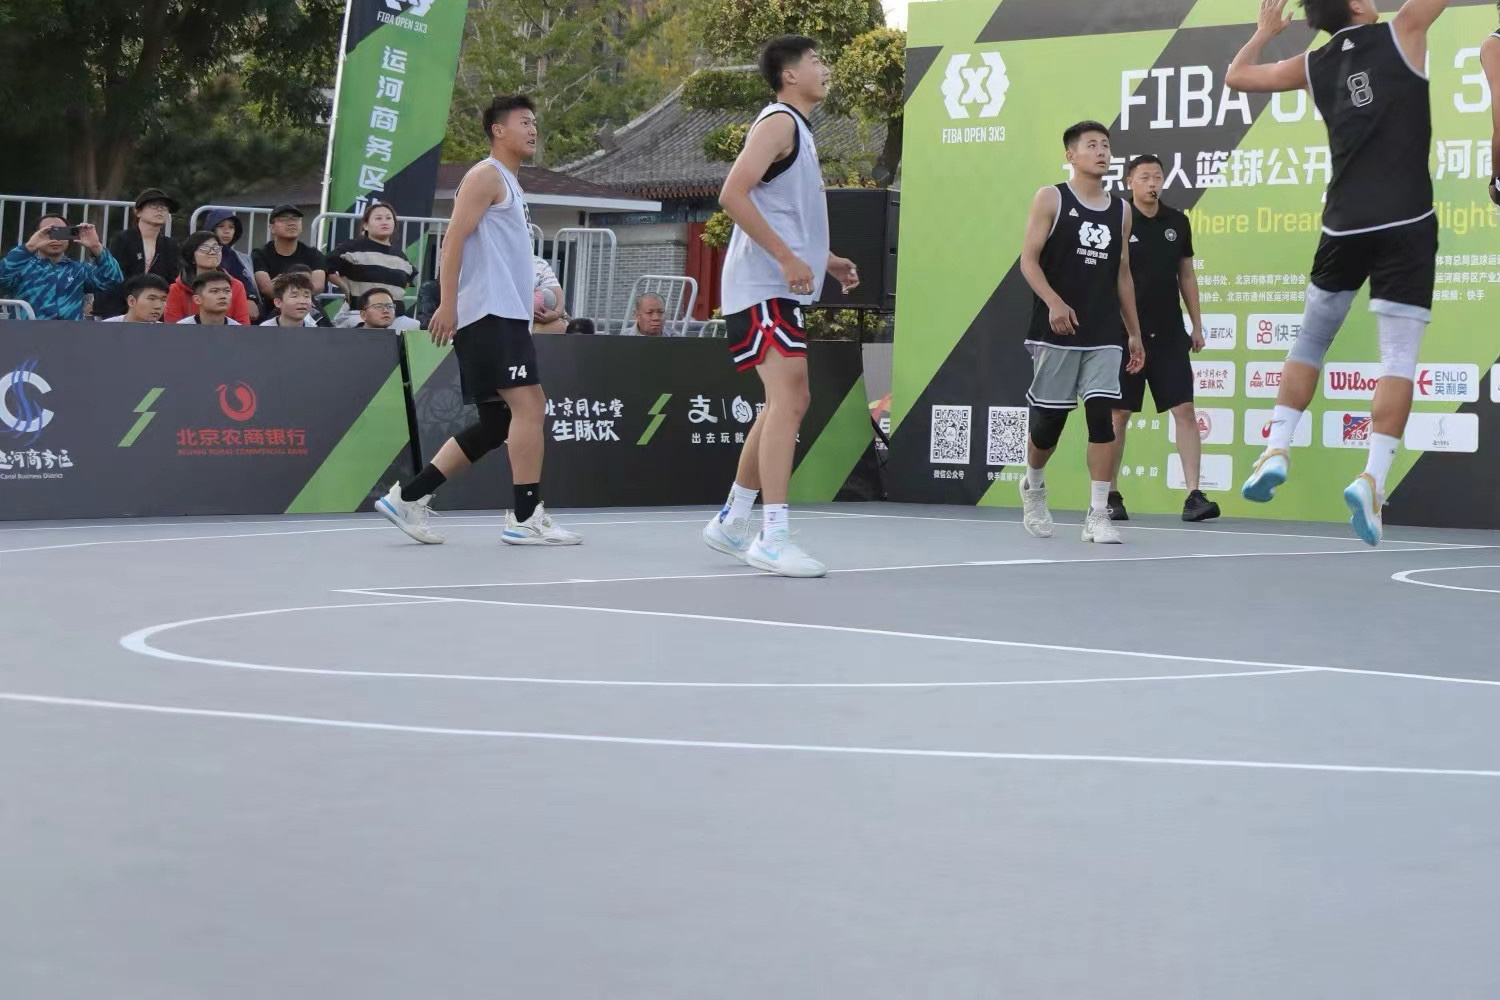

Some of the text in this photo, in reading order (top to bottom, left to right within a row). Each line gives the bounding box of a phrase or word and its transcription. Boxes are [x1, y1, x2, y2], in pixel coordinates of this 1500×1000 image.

[376, 10, 428, 34] FIBA OPEN 3X3
[1346, 71, 1374, 108] 8
[942, 125, 1006, 145] FIBA OPEN 3X3
[1433, 201, 1498, 234] light
[508, 364, 528, 380] 74
[1329, 371, 1378, 391] Wilso
[1434, 371, 1468, 382] ENLIO
[1434, 384, 1468, 395] 英利奥
[545, 397, 624, 418] 北京同仁堂
[176, 428, 306, 446] 北京农商银行
[552, 420, 621, 442] 生脉饮
[933, 469, 965, 480] 微信公众号
